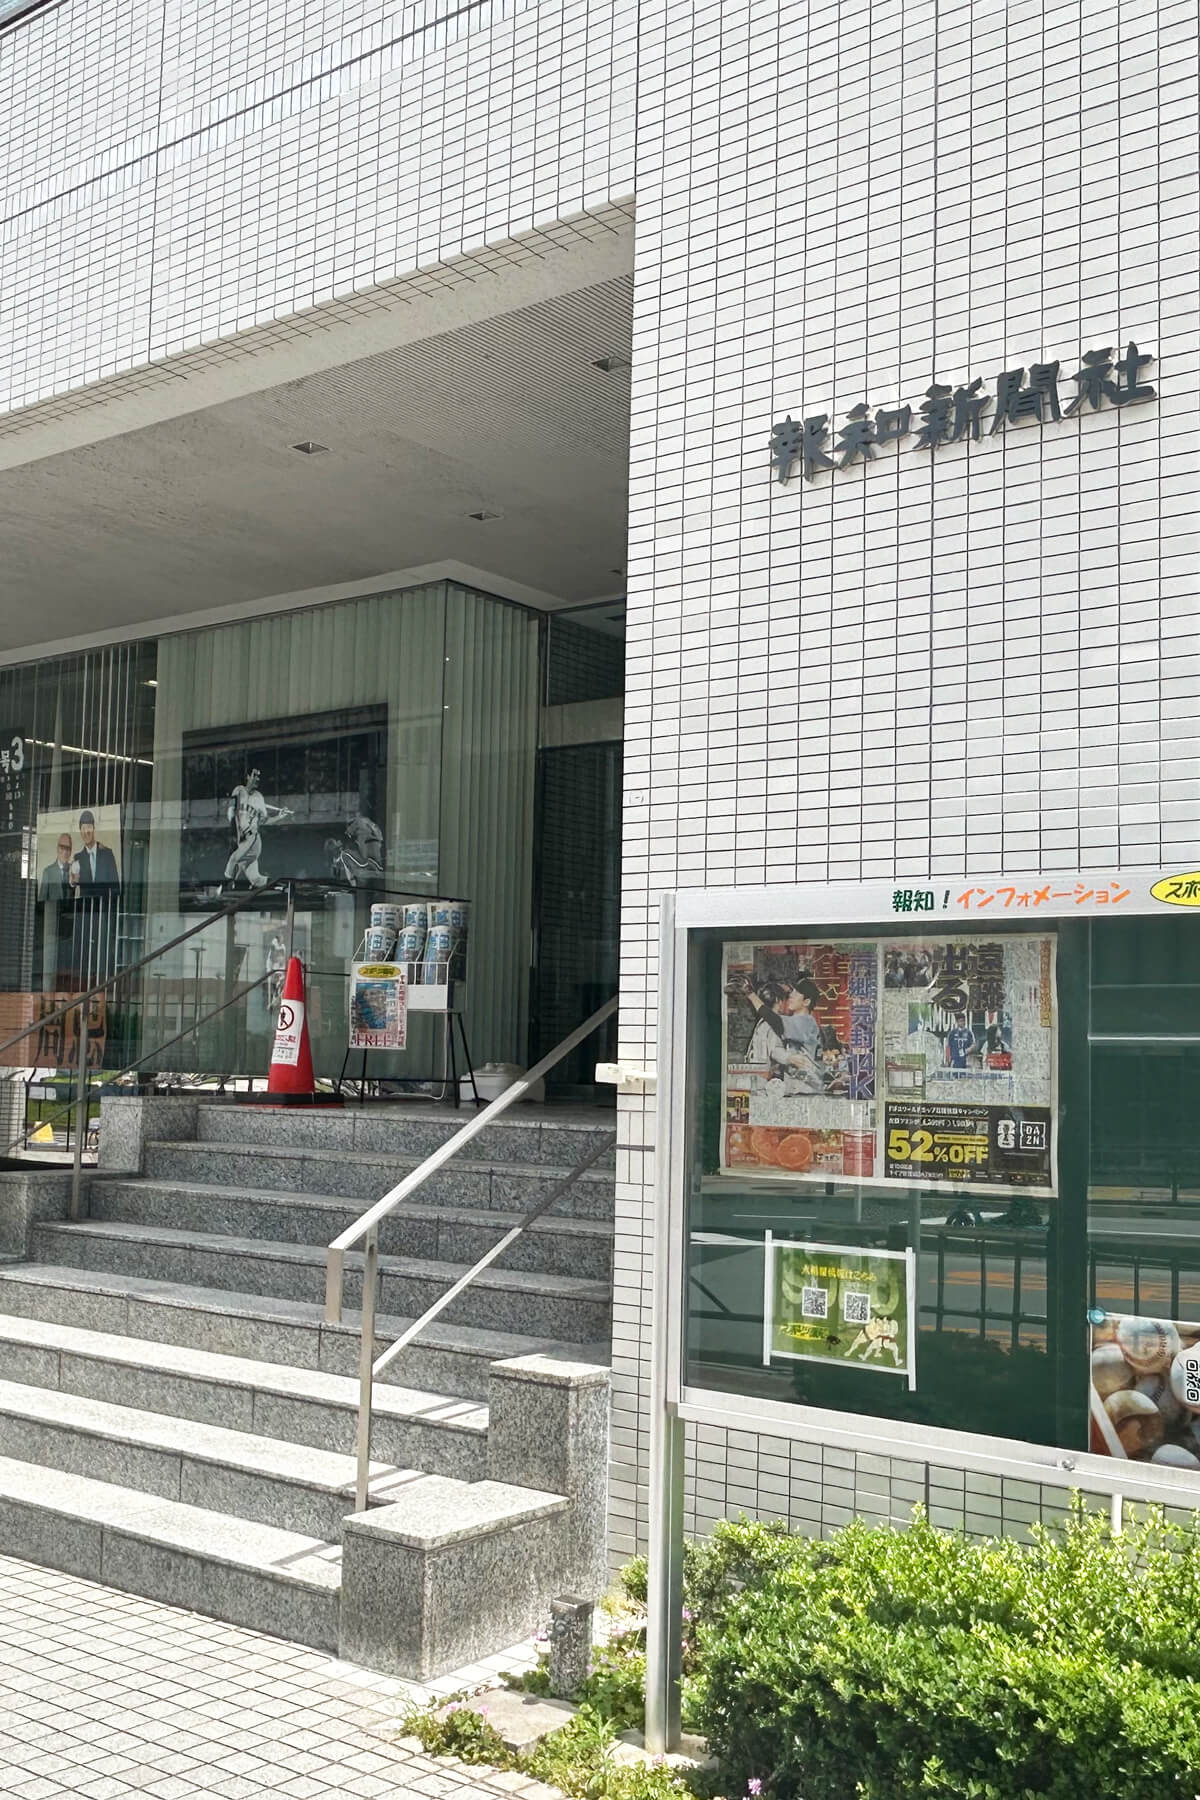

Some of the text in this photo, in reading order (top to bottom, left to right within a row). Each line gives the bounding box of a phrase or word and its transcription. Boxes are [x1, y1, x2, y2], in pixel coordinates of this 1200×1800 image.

[769, 341, 1159, 485] 報知新聞社
[957, 882, 1131, 909] インフォメーション
[1165, 880, 1200, 898] スポ
